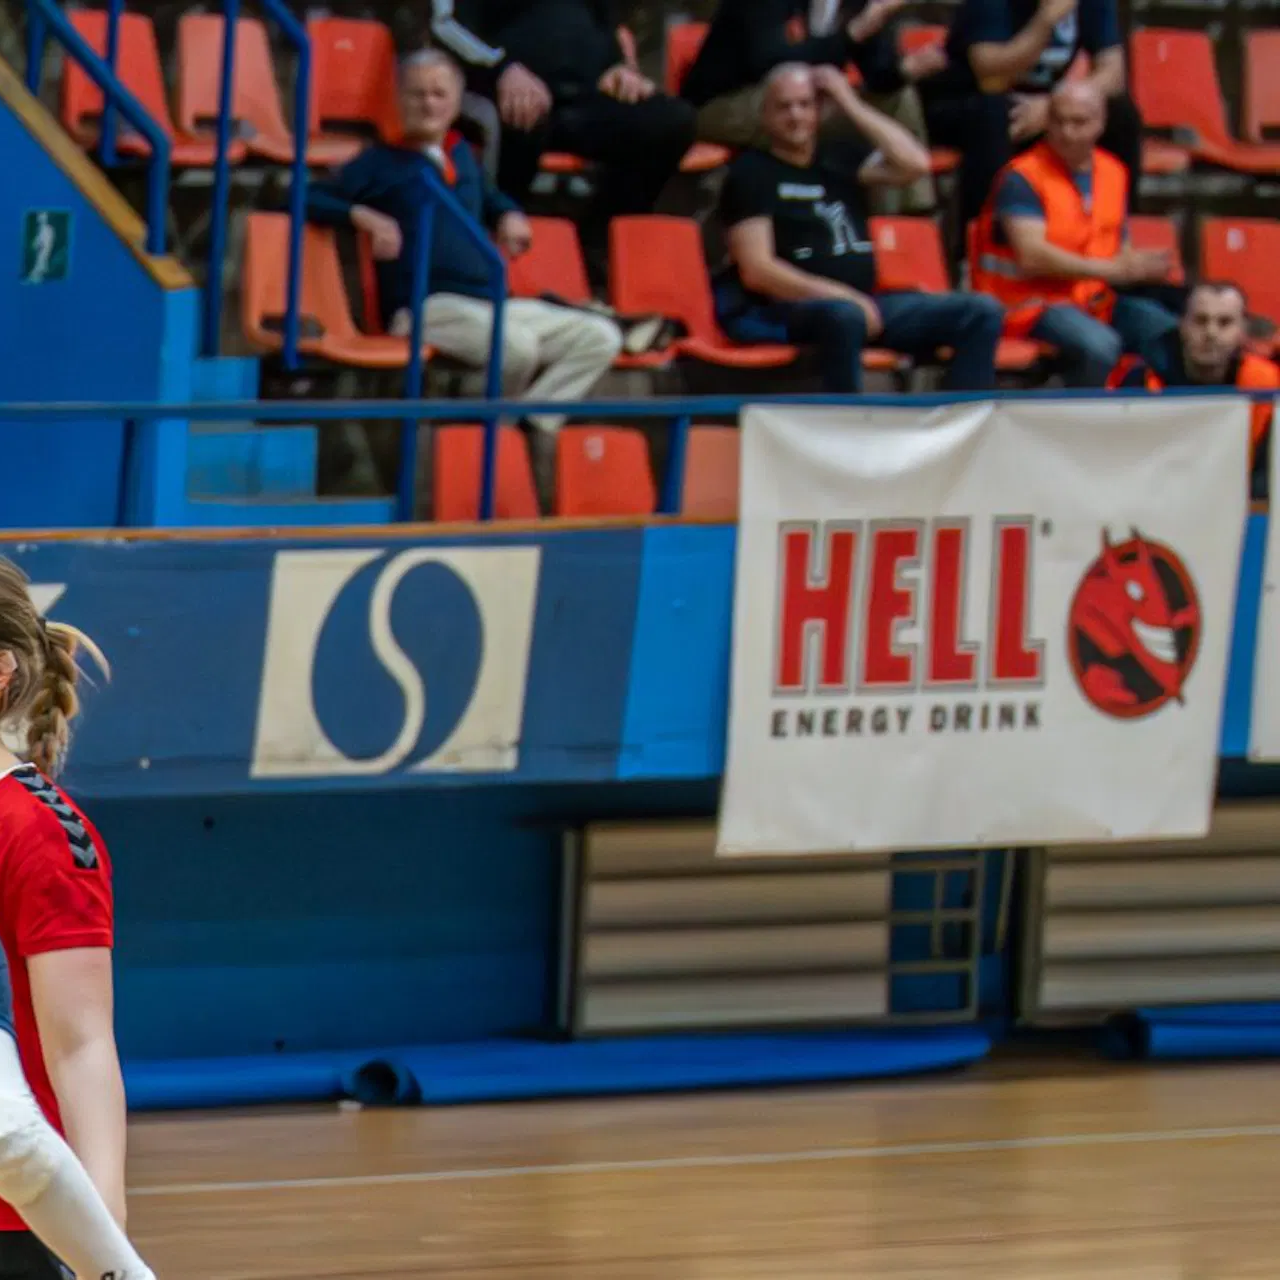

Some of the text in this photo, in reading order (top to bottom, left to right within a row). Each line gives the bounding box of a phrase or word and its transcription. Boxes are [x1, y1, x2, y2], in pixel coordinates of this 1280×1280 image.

[771, 515, 1046, 697] HELL
[770, 702, 1042, 738] ENERGY DRINK
